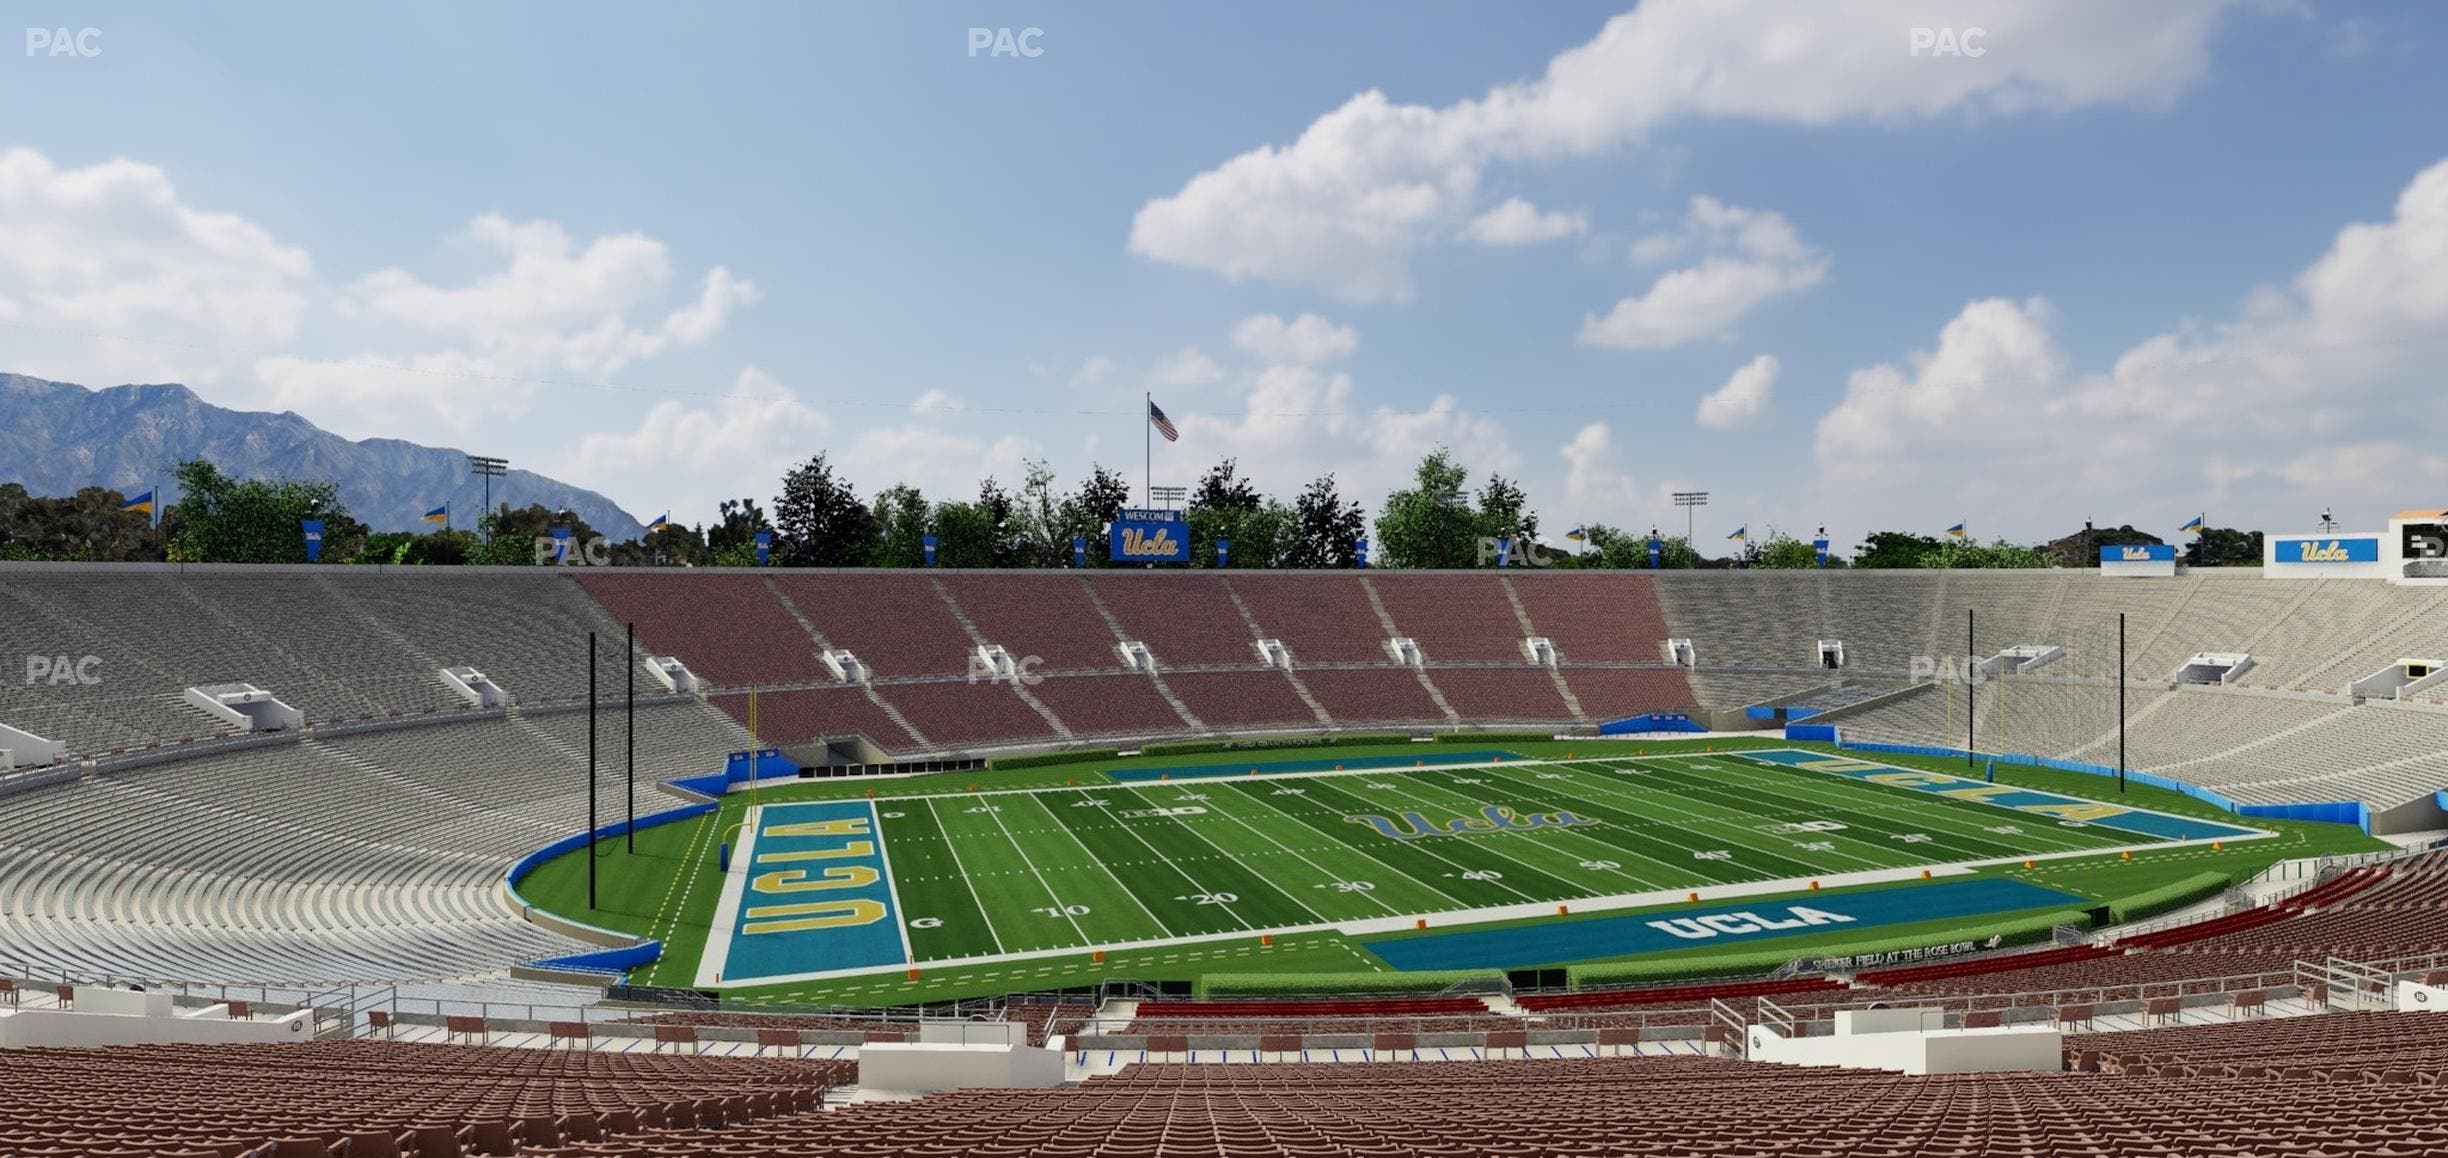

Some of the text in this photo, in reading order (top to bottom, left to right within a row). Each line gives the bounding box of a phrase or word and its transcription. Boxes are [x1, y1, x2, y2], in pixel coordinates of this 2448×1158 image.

[1125, 511, 1164, 521] WESCOM
[1121, 527, 1179, 556] Ucla
[2300, 541, 2349, 562] Ucla
[1343, 804, 1602, 839] Ucla
[1579, 860, 1621, 870] 50
[742, 817, 887, 936] UCLA
[1462, 870, 1503, 880] 40
[1331, 881, 1375, 892] 30
[1190, 892, 1238, 905] 20
[1042, 904, 1091, 917] 10
[909, 917, 944, 929] G
[1645, 906, 1857, 939] UCLA
[1856, 953, 1884, 966] FIELD
[1886, 951, 1900, 963] AT
[1902, 948, 1923, 960] THE
[1924, 944, 1949, 958] ROSE
[1950, 941, 1976, 954] BOWL
